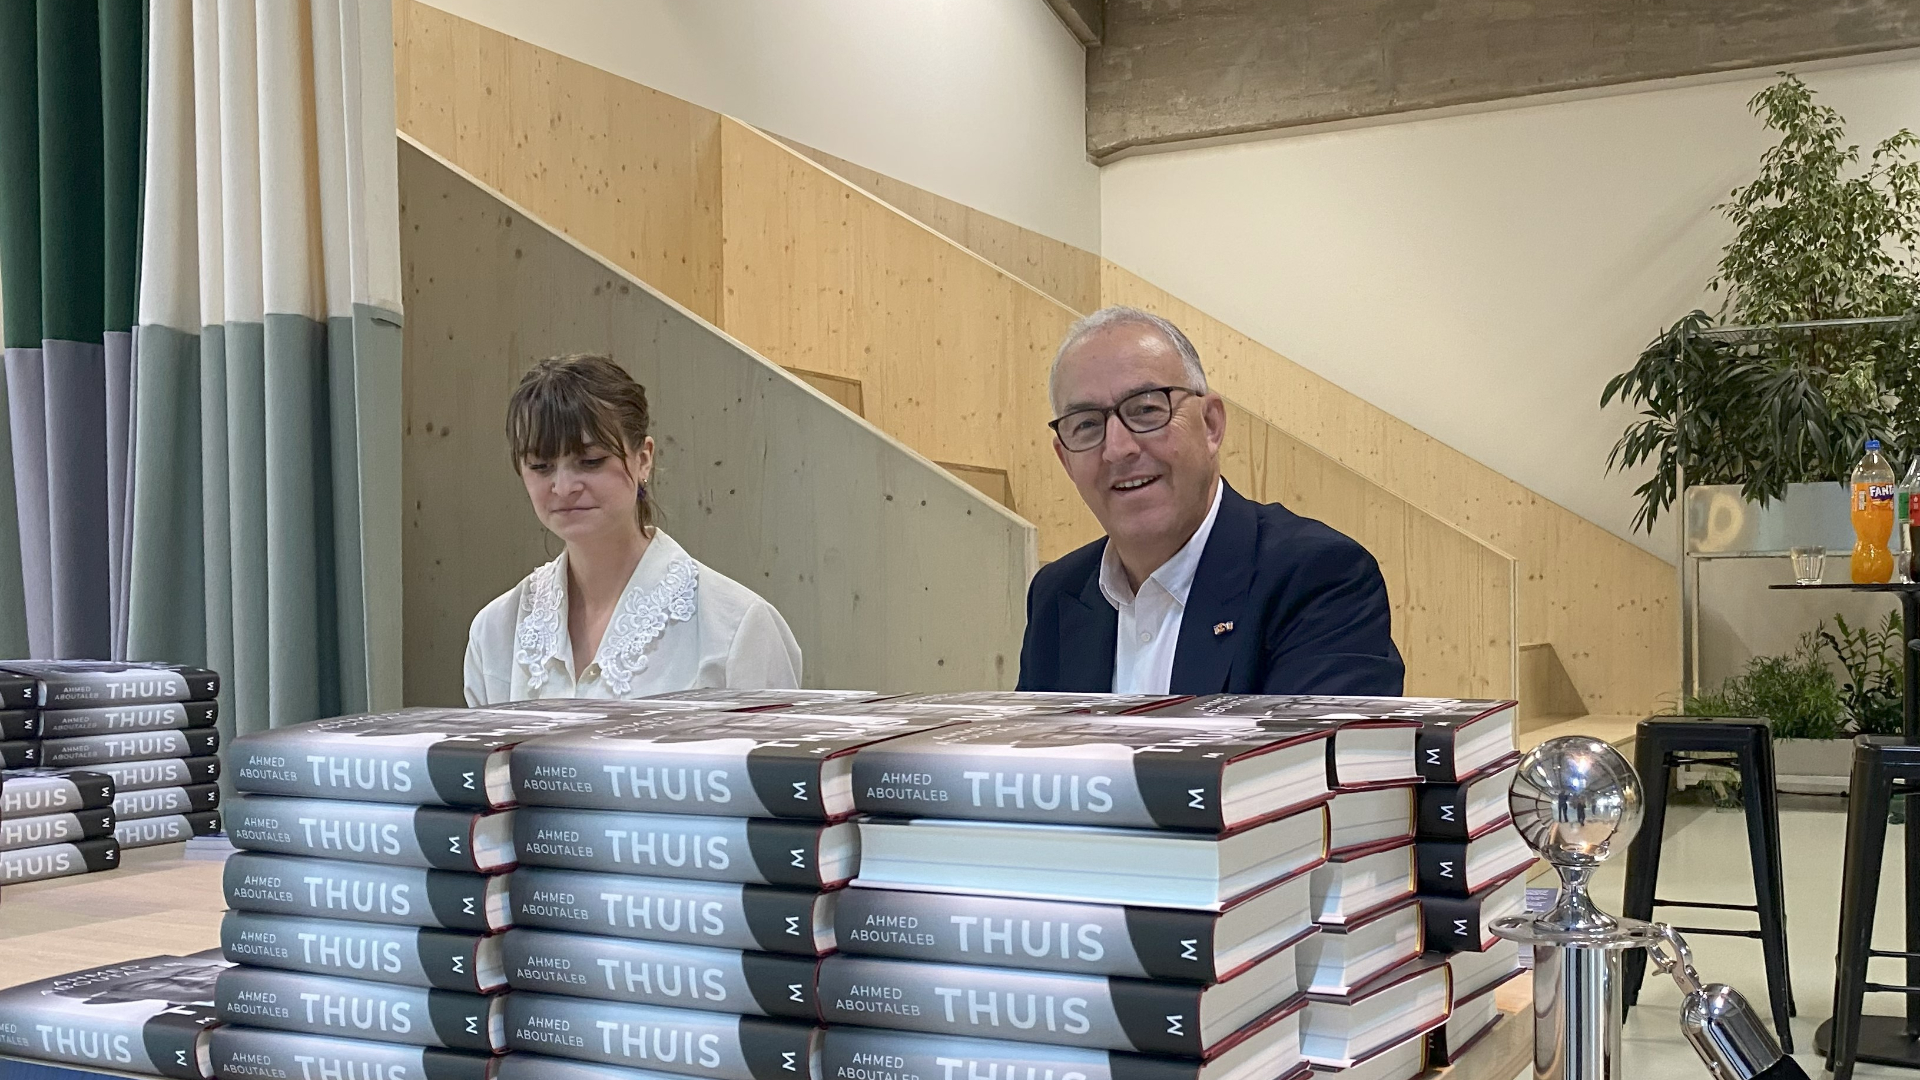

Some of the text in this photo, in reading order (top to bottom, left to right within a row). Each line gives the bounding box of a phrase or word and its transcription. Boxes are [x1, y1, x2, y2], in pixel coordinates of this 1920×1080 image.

[106, 681, 177, 699] THUIS
[104, 709, 175, 729] THUIS
[104, 736, 176, 757] THUIS
[249, 755, 285, 767] AHMED
[107, 765, 177, 786] THUIS
[239, 767, 297, 782] ABOUTALEB
[306, 755, 412, 792] THUIS
[534, 765, 577, 778] AHMED
[881, 772, 932, 785] AHMED
[523, 778, 593, 793] ABOUTALEB
[603, 765, 732, 803] THUIS
[963, 771, 1113, 813] THUIS
[4, 788, 67, 812] HUIS
[866, 787, 948, 802] ABOUTALEB
[5, 820, 68, 844] HUIS
[244, 817, 278, 830] AHMED
[236, 829, 291, 843] ABOUTALEB
[299, 818, 400, 855] THUIS
[537, 829, 579, 842] AHMED
[525, 842, 593, 858] ABOUTALEB
[604, 829, 730, 870] THUIS
[4, 852, 70, 878] HUIS
[244, 875, 281, 888] AHMED
[233, 888, 293, 902] ABOUTALEB
[303, 876, 410, 915] THUIS
[533, 890, 575, 905] AHMED
[521, 904, 589, 920] ABOUTALEB
[600, 893, 724, 935] THUIS
[865, 914, 918, 929] AHMED
[240, 930, 277, 944] AHMED
[850, 929, 935, 946] ABOUTALEB
[950, 916, 1104, 961] THUIS
[231, 943, 288, 958] ABOUTALEB
[298, 933, 401, 973] THUIS
[527, 955, 571, 970] AHMED
[516, 967, 587, 985] ABOUTALEB
[597, 958, 727, 1001] THUIS
[237, 990, 277, 1004] AHMED
[849, 984, 902, 1000] AHMED
[227, 1003, 289, 1018] ABOUTALEB
[300, 992, 411, 1033] THUIS
[835, 998, 921, 1016] ABOUTALEB
[934, 987, 1091, 1034] THUIS
[527, 1016, 570, 1031] AHMED
[36, 1024, 131, 1063] THUIS
[516, 1029, 584, 1048] ABOUTALEB
[596, 1020, 720, 1068] THUIS
[232, 1052, 271, 1066] AHMED
[852, 1052, 904, 1069] AHMED
[223, 1063, 287, 1079] ABOUTALEB
